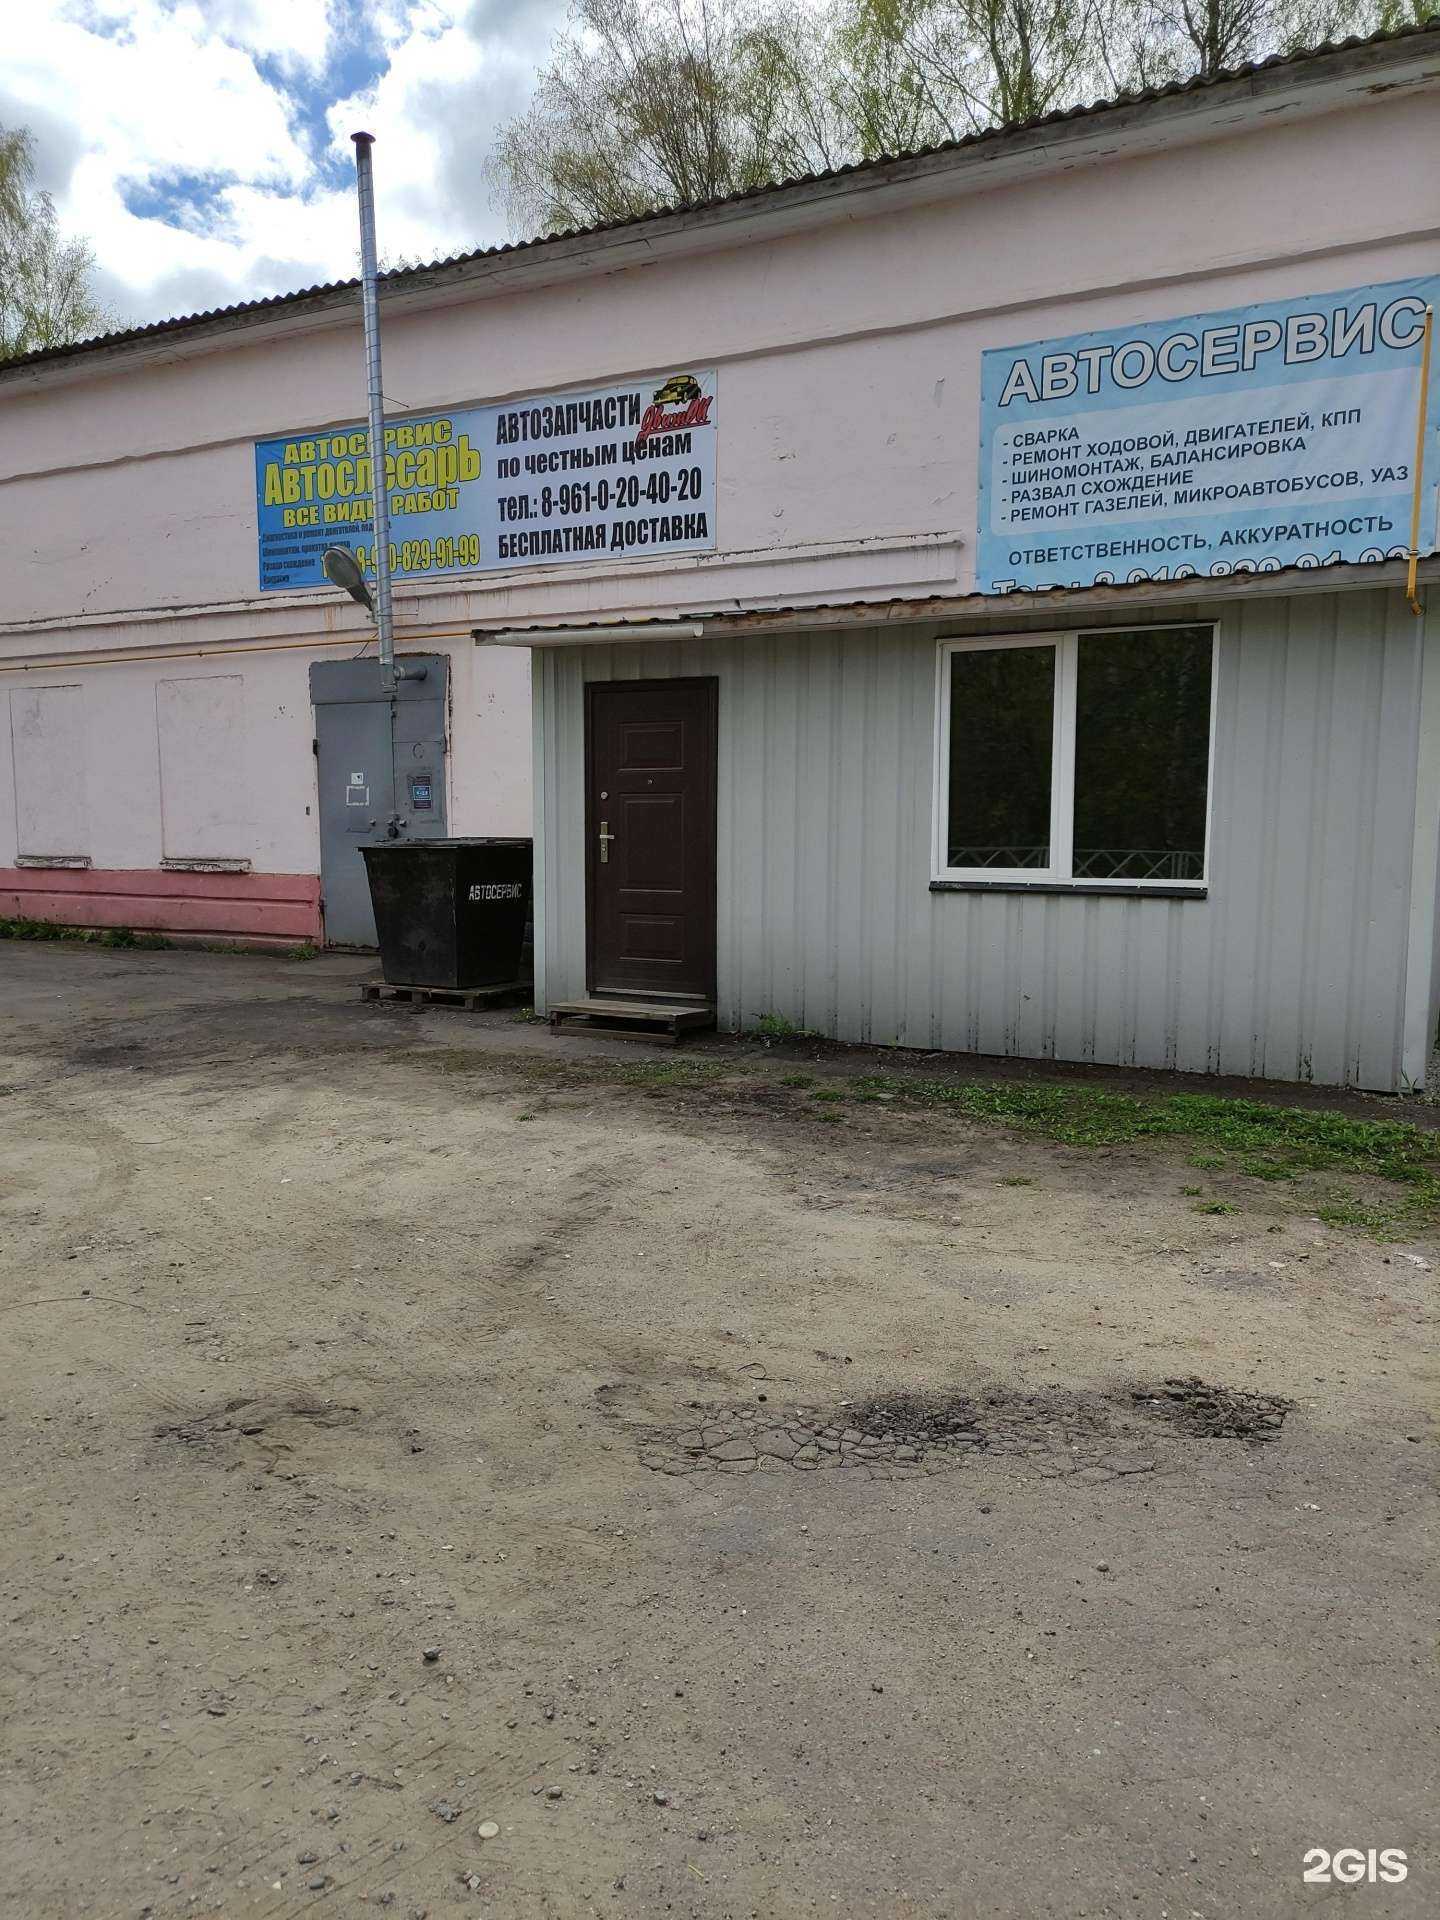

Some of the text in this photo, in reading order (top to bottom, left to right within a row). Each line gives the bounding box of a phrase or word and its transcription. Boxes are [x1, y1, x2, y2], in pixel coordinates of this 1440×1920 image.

[999, 296, 1428, 407] АВТОСЕРВИС
[284, 420, 453, 464] АВТОСРВИС
[496, 393, 641, 445] АВТОЗАПЧАСТИ
[1012, 408, 1361, 466] РЕМОНТ ХОДОВОЙ, ДВИГАТЕЛЕЙ, КПП
[1013, 427, 1079, 448] СВАРКА
[497, 456, 520, 478] по
[524, 442, 617, 475] честным
[1012, 436, 1307, 485] ШИНОМОНТАЖ, БАЛАНСИРОВКА
[283, 506, 320, 528] ВСЕ
[392, 488, 460, 515] РАБОТ
[497, 466, 702, 522] тел.: 8-961-0-20-40-20
[1010, 465, 1409, 522] РЕМОНТ ГАЗЕЛЕЙ, МИКРОАВТОБУСОВ, УАЗ
[1011, 469, 1193, 504] РАЗВАЛ СХОЖДЕНИЕ
[355, 533, 481, 575] 8-90-829-91-99
[498, 512, 708, 559] БЕСПЛАТНАЯ ДОСТАВКА
[1008, 533, 1212, 566] ОТВЕТСТВЕННОСТЬ,
[1218, 515, 1393, 546] АККУРАТНОСТЬ
[468, 883, 522, 900] АВТОСЕРВИС
